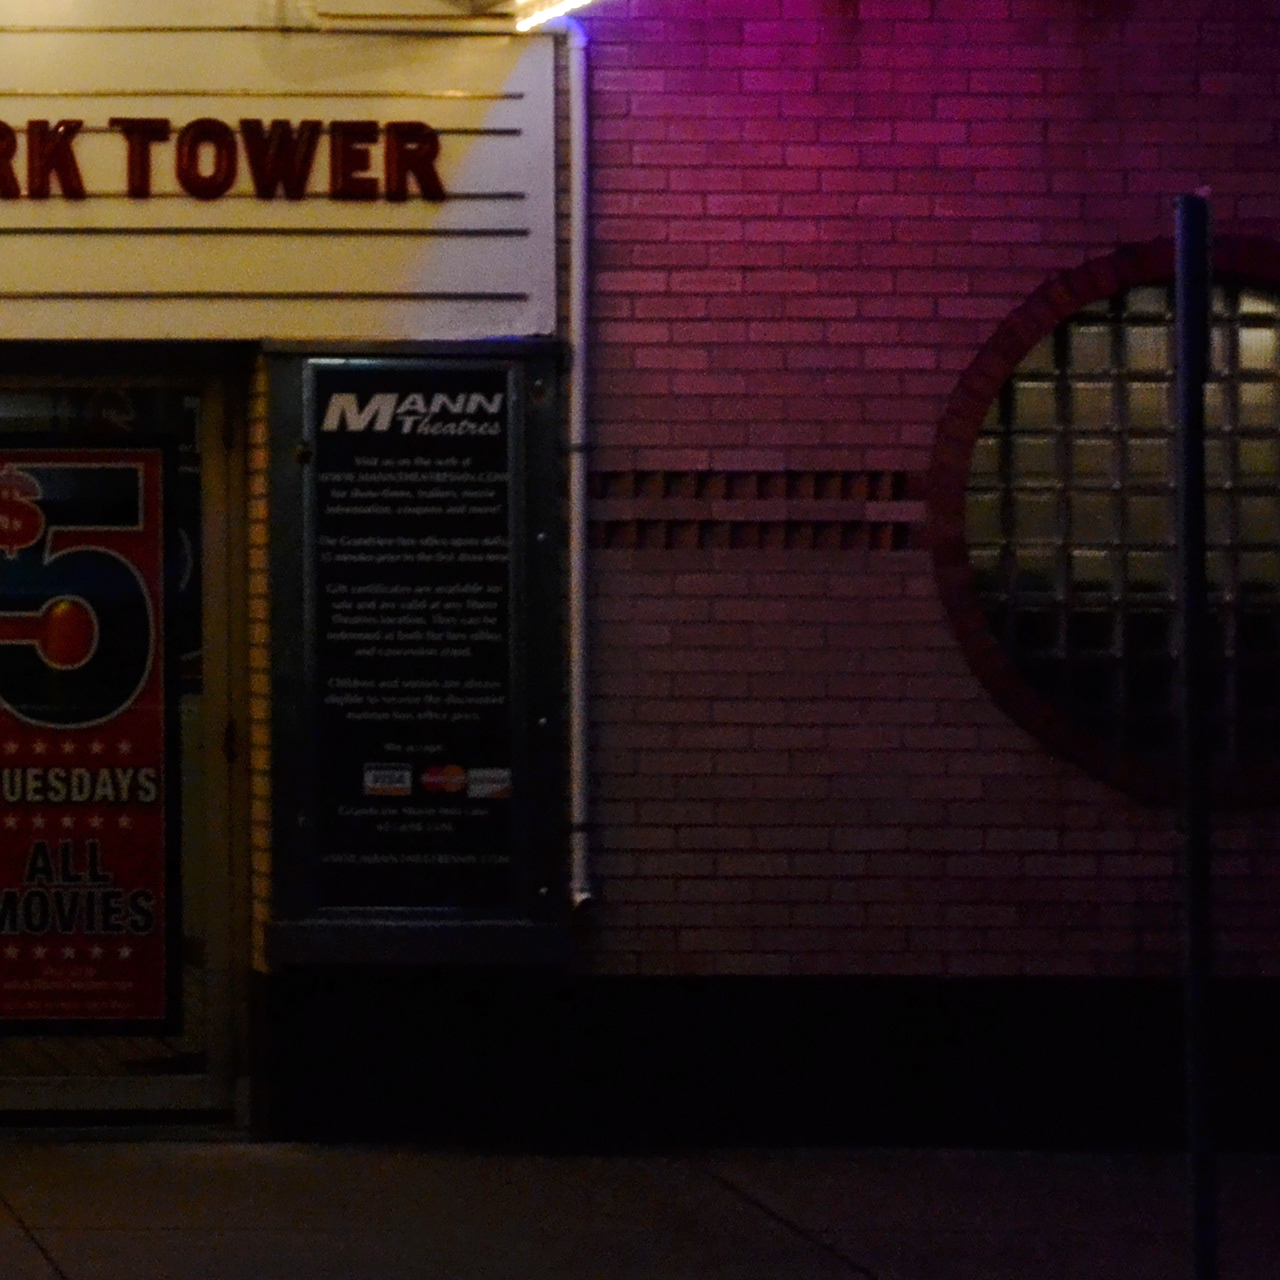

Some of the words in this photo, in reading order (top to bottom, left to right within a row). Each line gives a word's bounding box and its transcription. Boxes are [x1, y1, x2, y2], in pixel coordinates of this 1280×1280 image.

[109, 117, 445, 202] TOWER
[320, 392, 505, 433] MANN
[395, 414, 502, 436] Theatres
[22, 836, 114, 885] ALL
